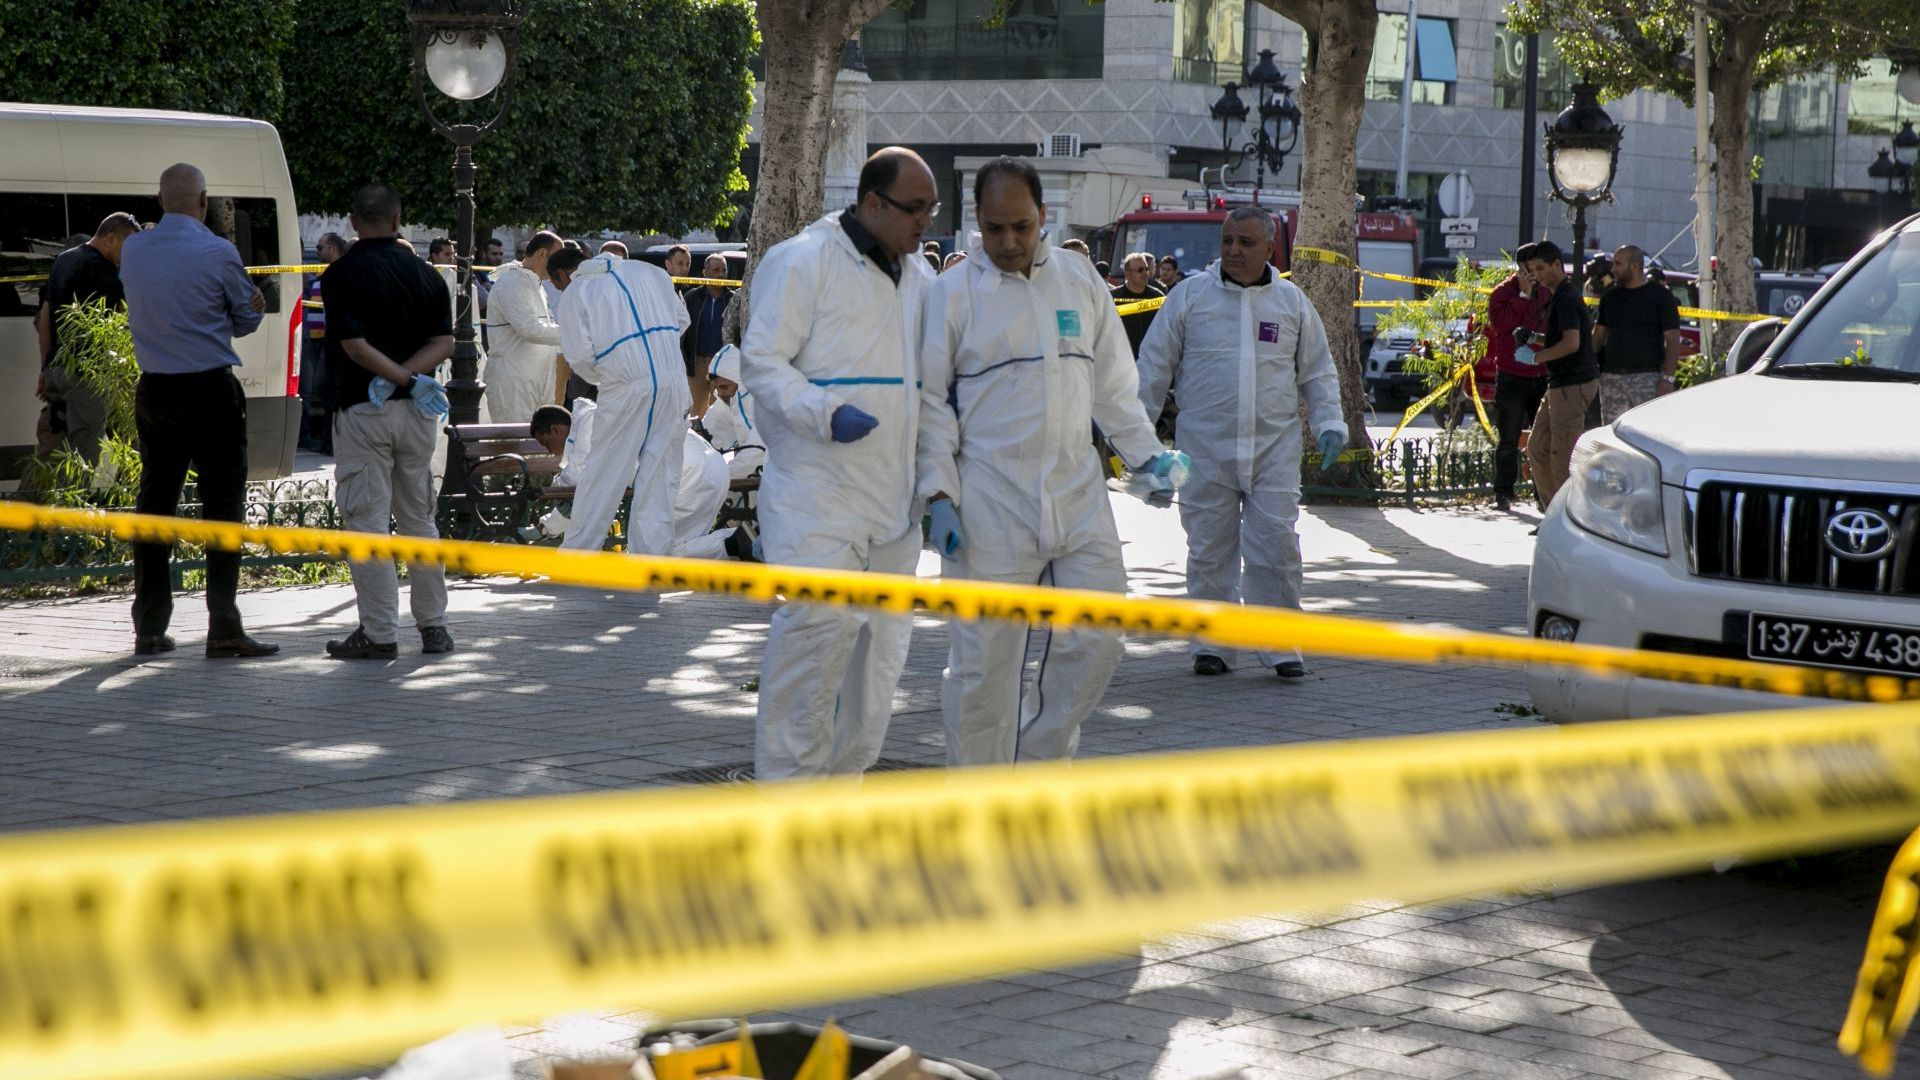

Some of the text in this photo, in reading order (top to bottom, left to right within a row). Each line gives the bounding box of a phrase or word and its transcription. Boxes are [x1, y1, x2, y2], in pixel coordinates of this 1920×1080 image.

[1303, 250, 1321, 260] CROSS
[1812, 628, 1862, 660] تونس
[538, 832, 780, 976] CRIME
[786, 806, 992, 942] SCENE
[990, 800, 1080, 912] DO
[1080, 792, 1184, 898] NOT
